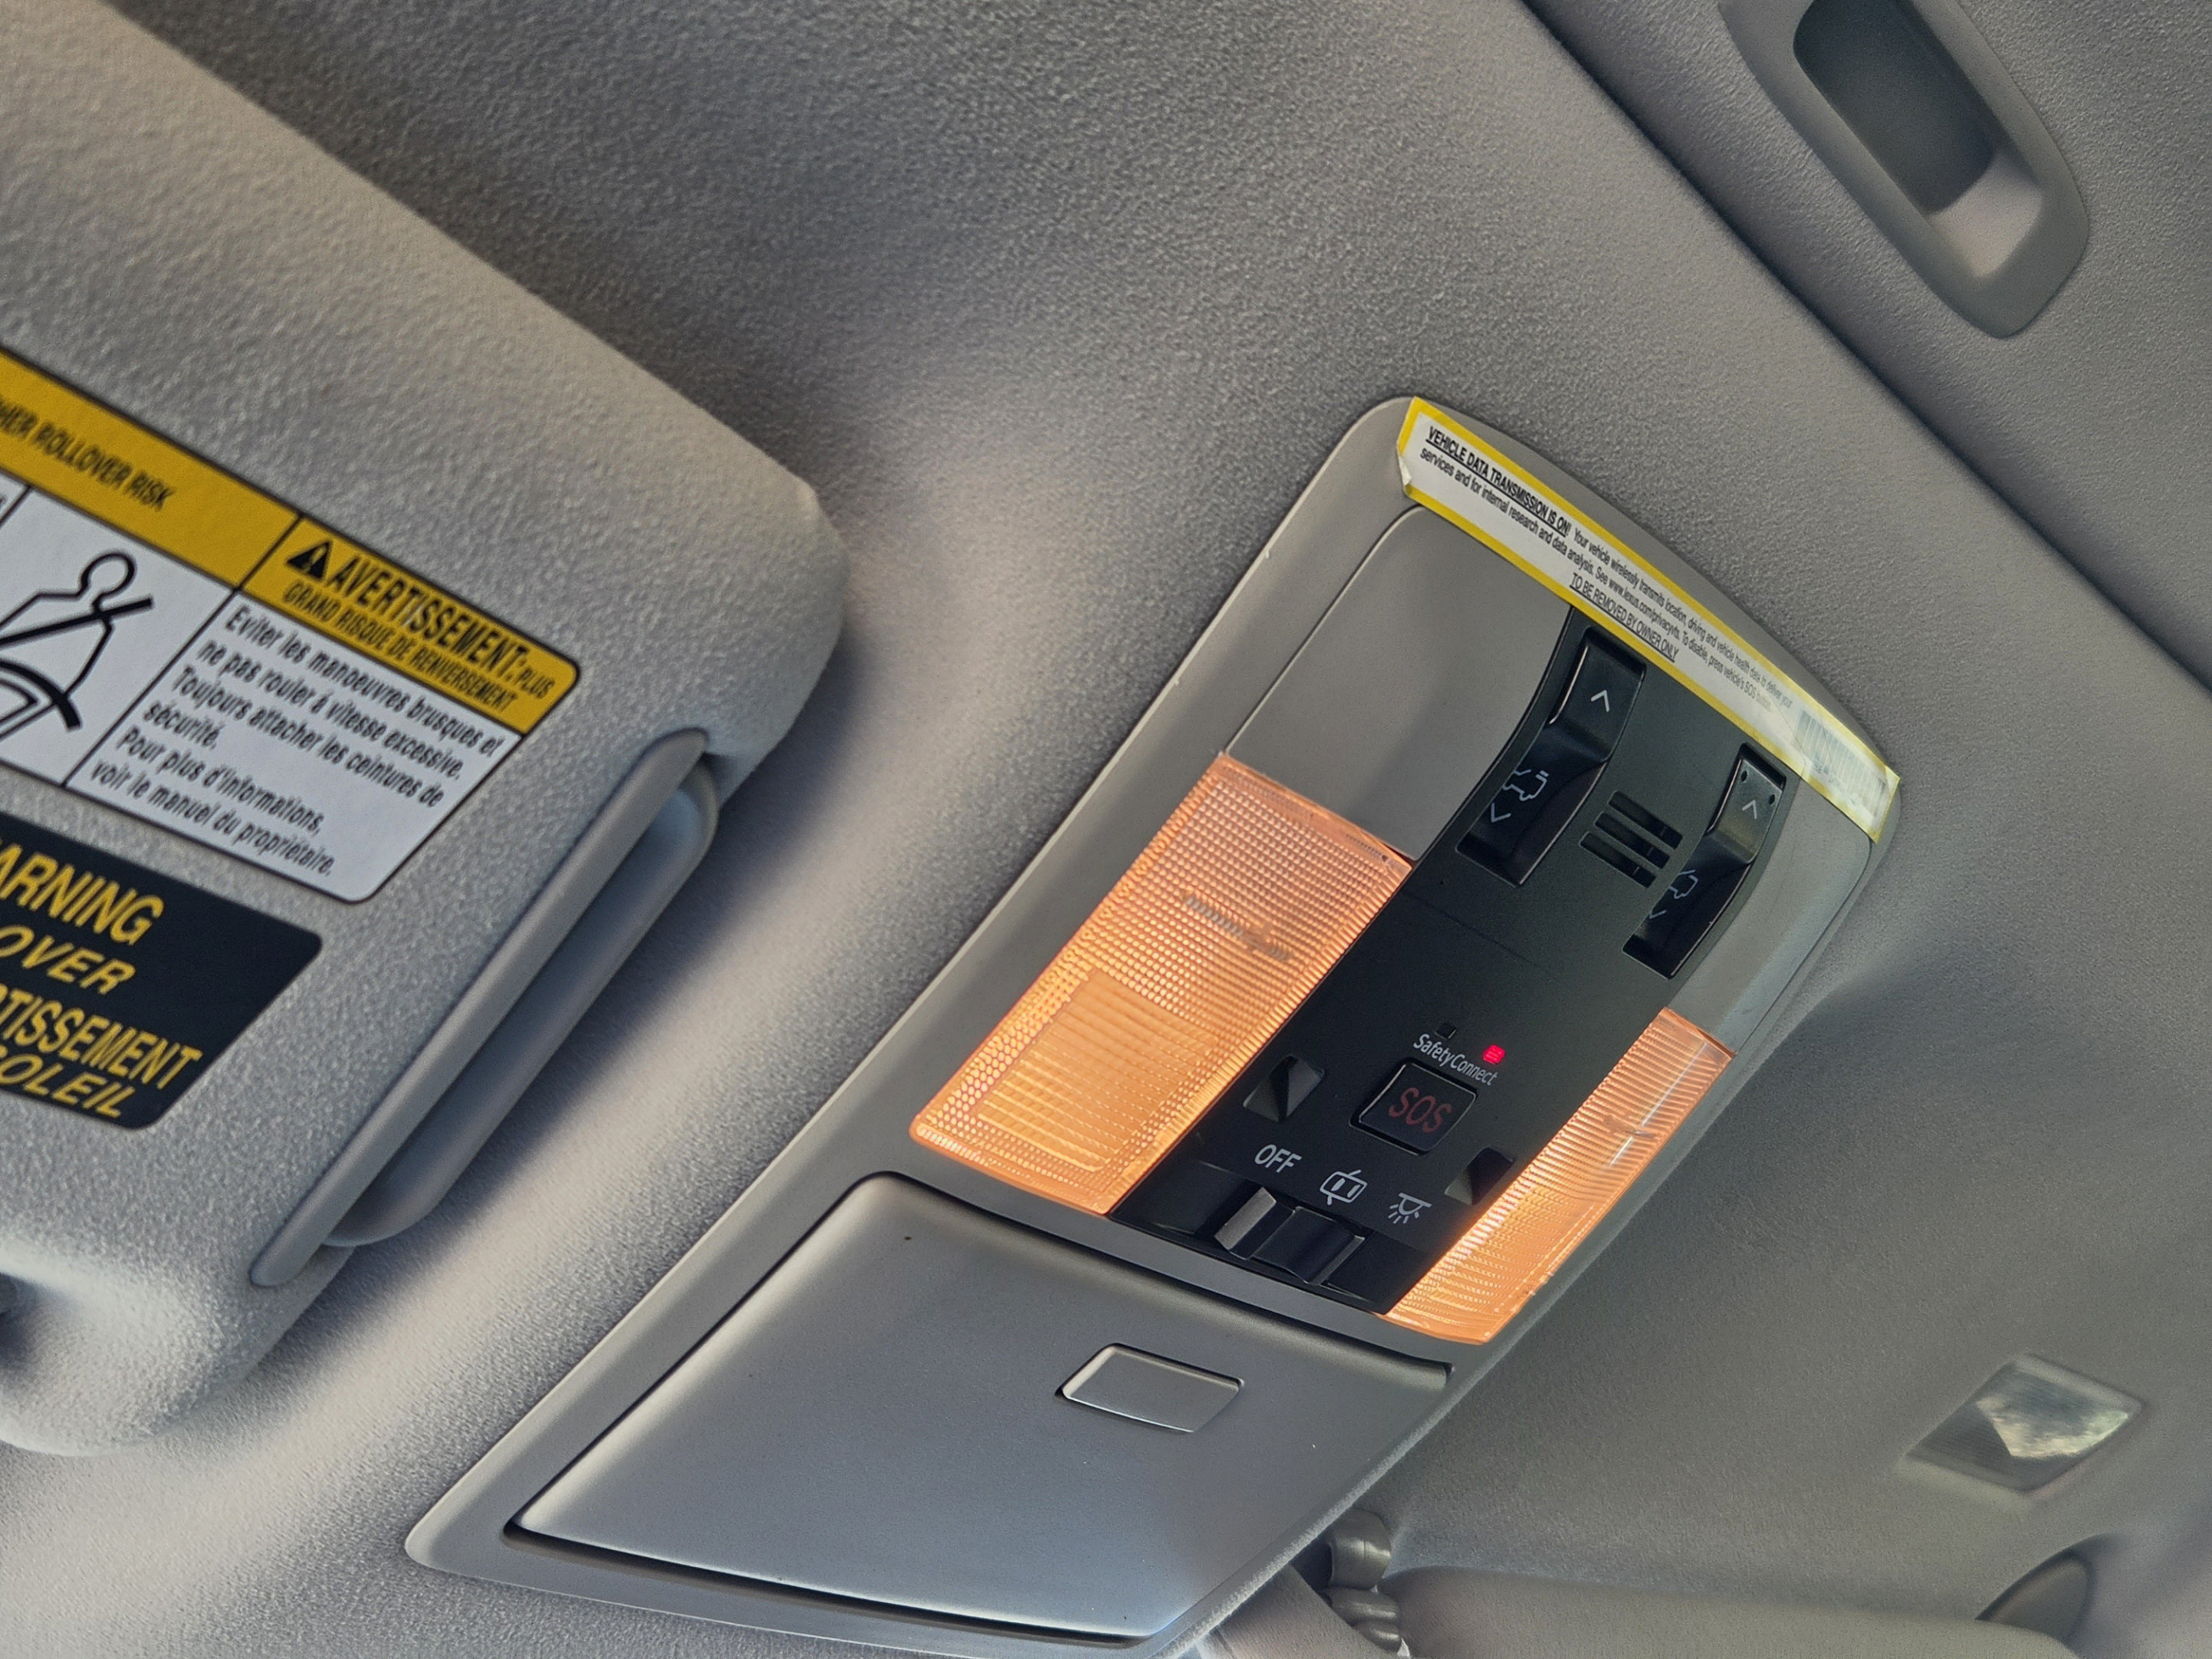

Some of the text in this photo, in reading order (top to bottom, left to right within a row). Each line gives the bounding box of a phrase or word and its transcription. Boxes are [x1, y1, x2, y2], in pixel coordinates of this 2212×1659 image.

[32, 422, 132, 490] ROLLOVER
[126, 471, 175, 513] RISK
[1420, 447, 1455, 476] services
[1455, 469, 1472, 488] and
[1470, 476, 1482, 495] for
[1482, 485, 1509, 514] internal
[1508, 506, 1539, 535] research
[1538, 527, 1553, 545] and
[1551, 536, 1568, 556] data
[1567, 548, 1594, 575] analysis.
[1595, 566, 1608, 585] See
[1682, 631, 1689, 646] To
[1688, 638, 1708, 664] disable,
[1707, 655, 1724, 674] press
[1743, 680, 1757, 699] SOS
[1429, 426, 1468, 462] VEHICLE
[1467, 452, 1490, 478] DATA
[1490, 467, 1549, 518] TRANSMISSION
[1547, 509, 1558, 525] IS
[1557, 516, 1572, 536] ON!
[1574, 527, 1589, 548] Your
[1588, 542, 1611, 565] vehicle
[1611, 558, 1640, 590] wirelessly
[1638, 578, 1666, 608] transmits
[1664, 598, 1687, 627] location,
[1687, 617, 1707, 642] driving
[1705, 632, 1717, 648] and
[1717, 641, 1735, 662] vehicle
[283, 581, 518, 713] GRAND RISQUE DE RENVERSEMENT
[325, 555, 555, 700] AVERTISSEMENT: PLUS
[1571, 572, 1680, 661] TO BE REMOVED BY OWNER ONLY
[143, 700, 225, 750] sécurité.
[174, 664, 445, 807] Toujours attacher les ceintures de
[197, 641, 227, 667] ne
[217, 653, 262, 683] pas
[257, 669, 316, 707] rouler
[326, 700, 388, 742] vitesse
[383, 729, 463, 780] excessive.
[277, 631, 311, 664] les
[308, 651, 411, 713] manoeuvres
[406, 694, 484, 748] brusques
[478, 735, 505, 758] et
[117, 725, 166, 763] Pour
[155, 749, 206, 782] plus
[91, 759, 335, 876] voir le manuel du propriétaire.
[0, 838, 164, 946] ARNING
[0, 924, 137, 995] OVER
[0, 983, 204, 1090] TISSEMENT
[0, 1044, 136, 1118] OLEIL
[1254, 1144, 1302, 1174] OFF
[1389, 1087, 1452, 1134] SOS
